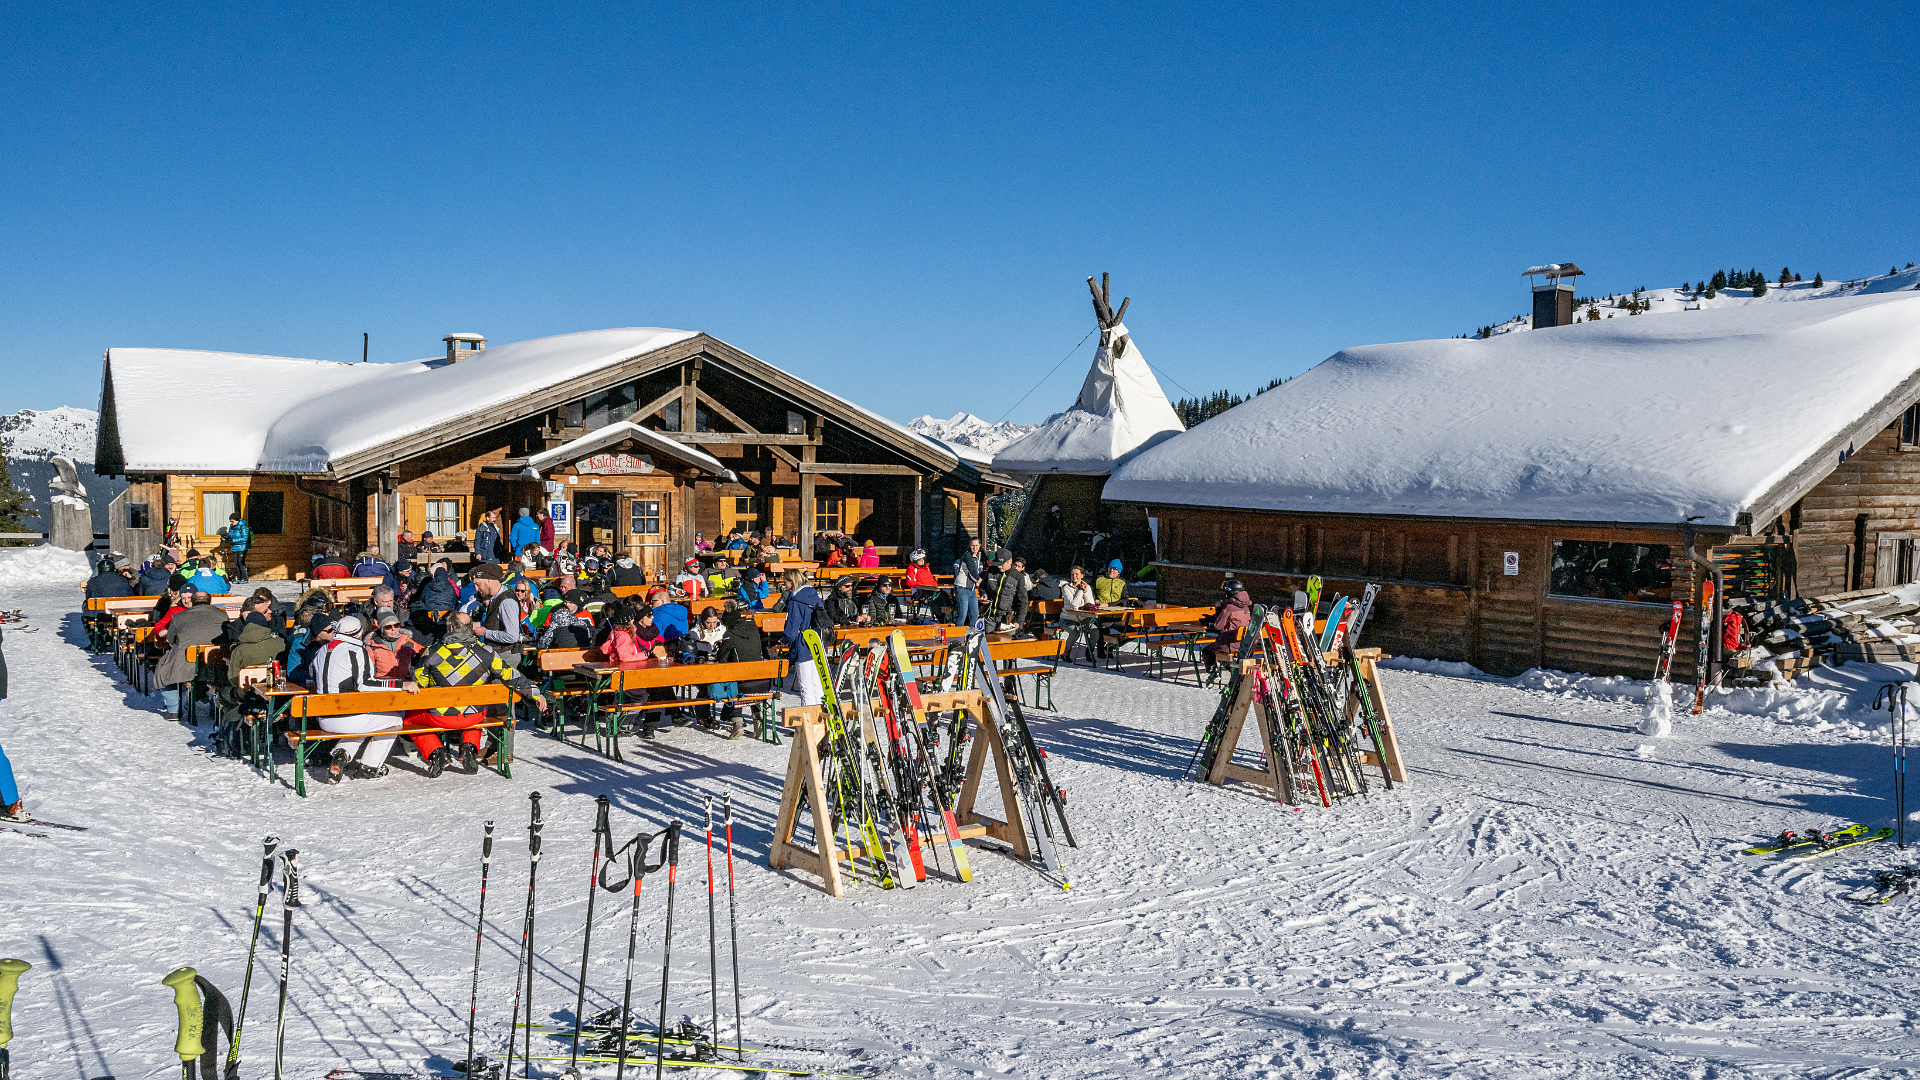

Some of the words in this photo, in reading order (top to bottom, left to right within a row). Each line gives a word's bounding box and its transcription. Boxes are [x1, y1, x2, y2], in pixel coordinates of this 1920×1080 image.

[1352, 591, 1372, 635] HEAD
[812, 643, 830, 690] HEAD
[280, 953, 288, 981] LEKI
